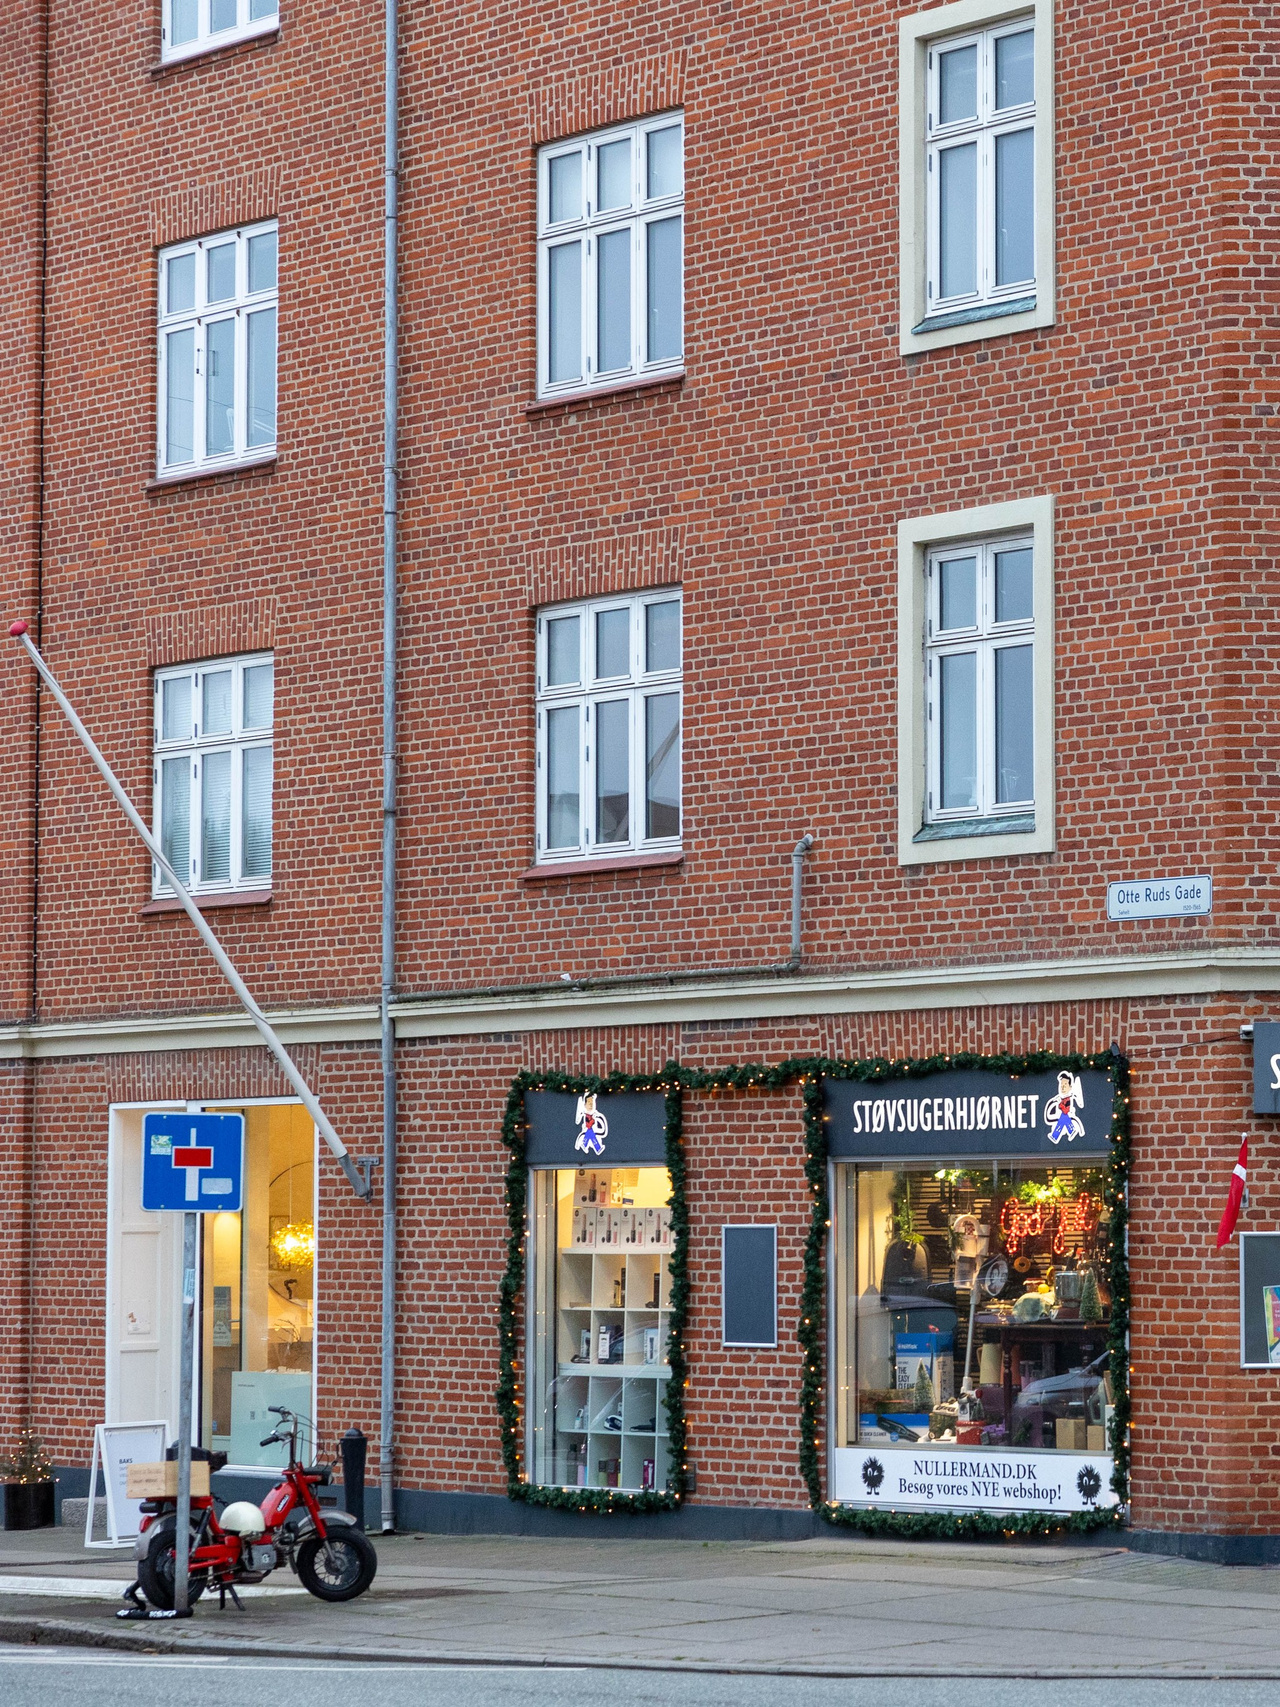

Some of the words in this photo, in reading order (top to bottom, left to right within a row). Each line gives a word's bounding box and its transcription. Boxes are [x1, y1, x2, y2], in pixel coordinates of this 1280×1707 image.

[1117, 889, 1140, 904] Otte
[1145, 886, 1170, 902] Ruds
[1174, 884, 1202, 900] Gade
[853, 1094, 1040, 1134] STØVSUGERHJØRNET
[914, 1460, 1037, 1480] NULLERMAND.DK
[899, 1478, 934, 1499] Besøg
[936, 1482, 968, 1496] vores
[971, 1481, 999, 1497] NYE
[1003, 1484, 1061, 1504] webshop!
